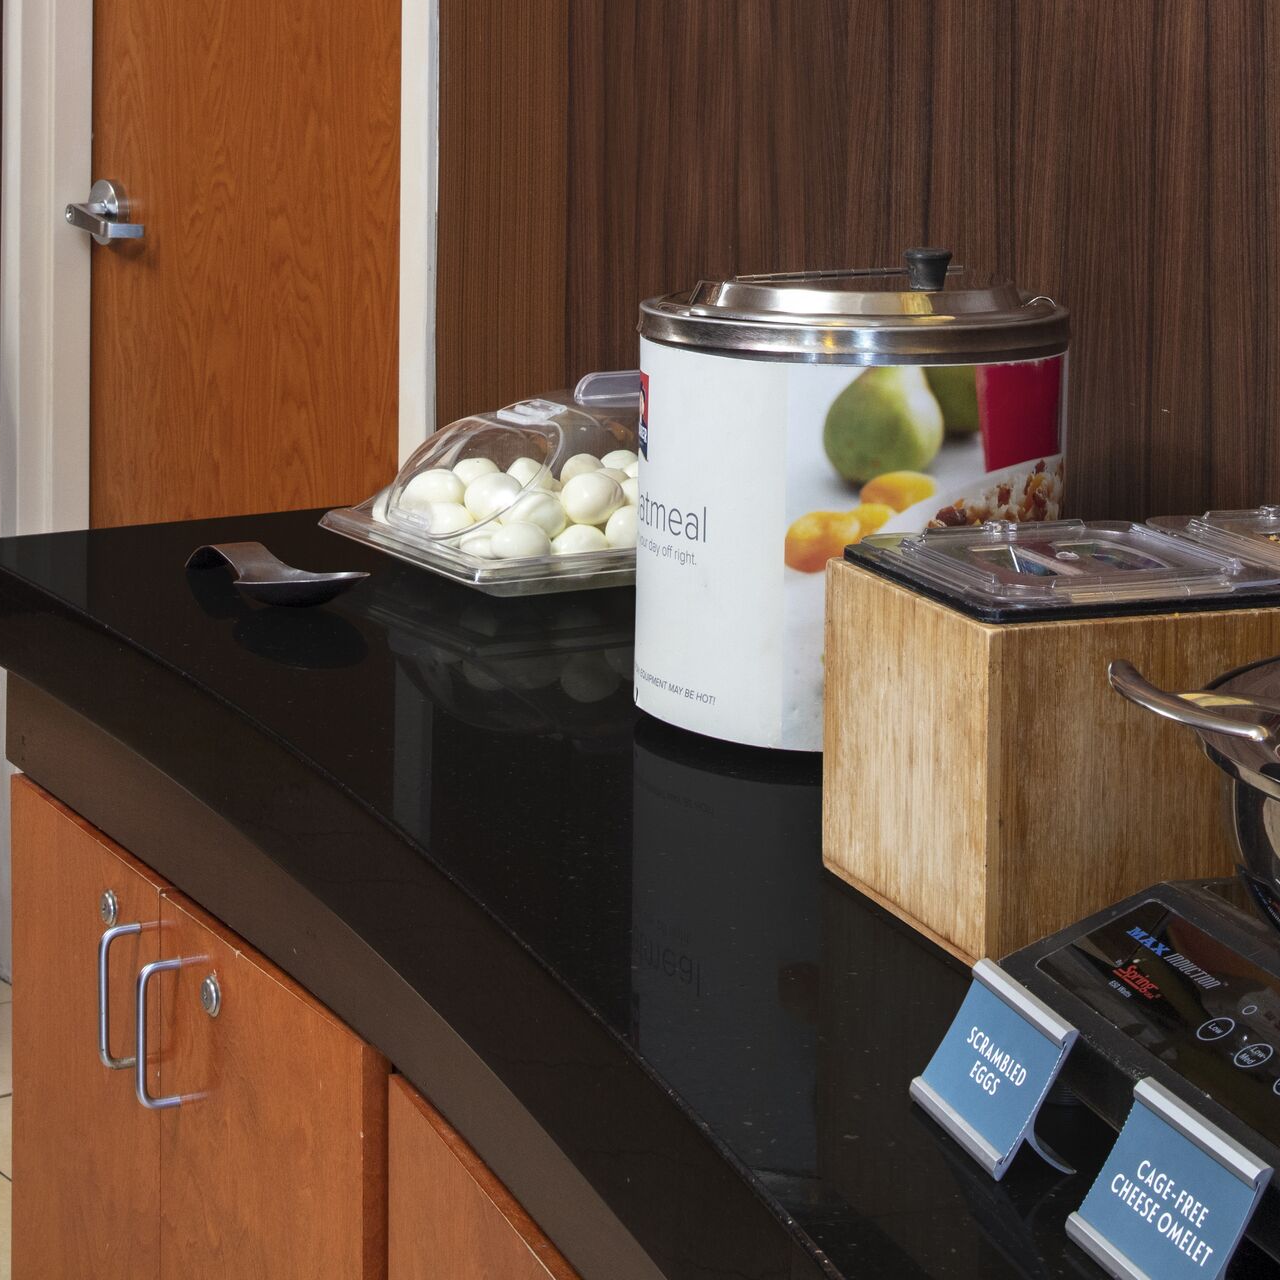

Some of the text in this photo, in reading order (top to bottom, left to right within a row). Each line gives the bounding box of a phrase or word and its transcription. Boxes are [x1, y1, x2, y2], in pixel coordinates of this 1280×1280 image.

[637, 491, 707, 543] atmeal
[649, 538, 660, 557] day
[662, 544, 673, 558] off
[675, 548, 697, 566] right.
[640, 667, 667, 690] EQUIPMENT
[668, 683, 683, 696] MAY
[684, 688, 695, 700] BE
[696, 692, 716, 706] HOT!
[1126, 926, 1171, 957] MAX
[1113, 964, 1160, 995] Spring
[1117, 984, 1133, 999] Watts
[1208, 1022, 1224, 1035] Low
[966, 1026, 1027, 1087] SCRAMBLED
[1239, 1052, 1256, 1065] Med
[1250, 1045, 1267, 1059] Low-
[969, 1060, 1001, 1096] EGGS
[1136, 1160, 1210, 1229] CAGE-FREE
[1111, 1173, 1214, 1267] CHEESE OMELET
